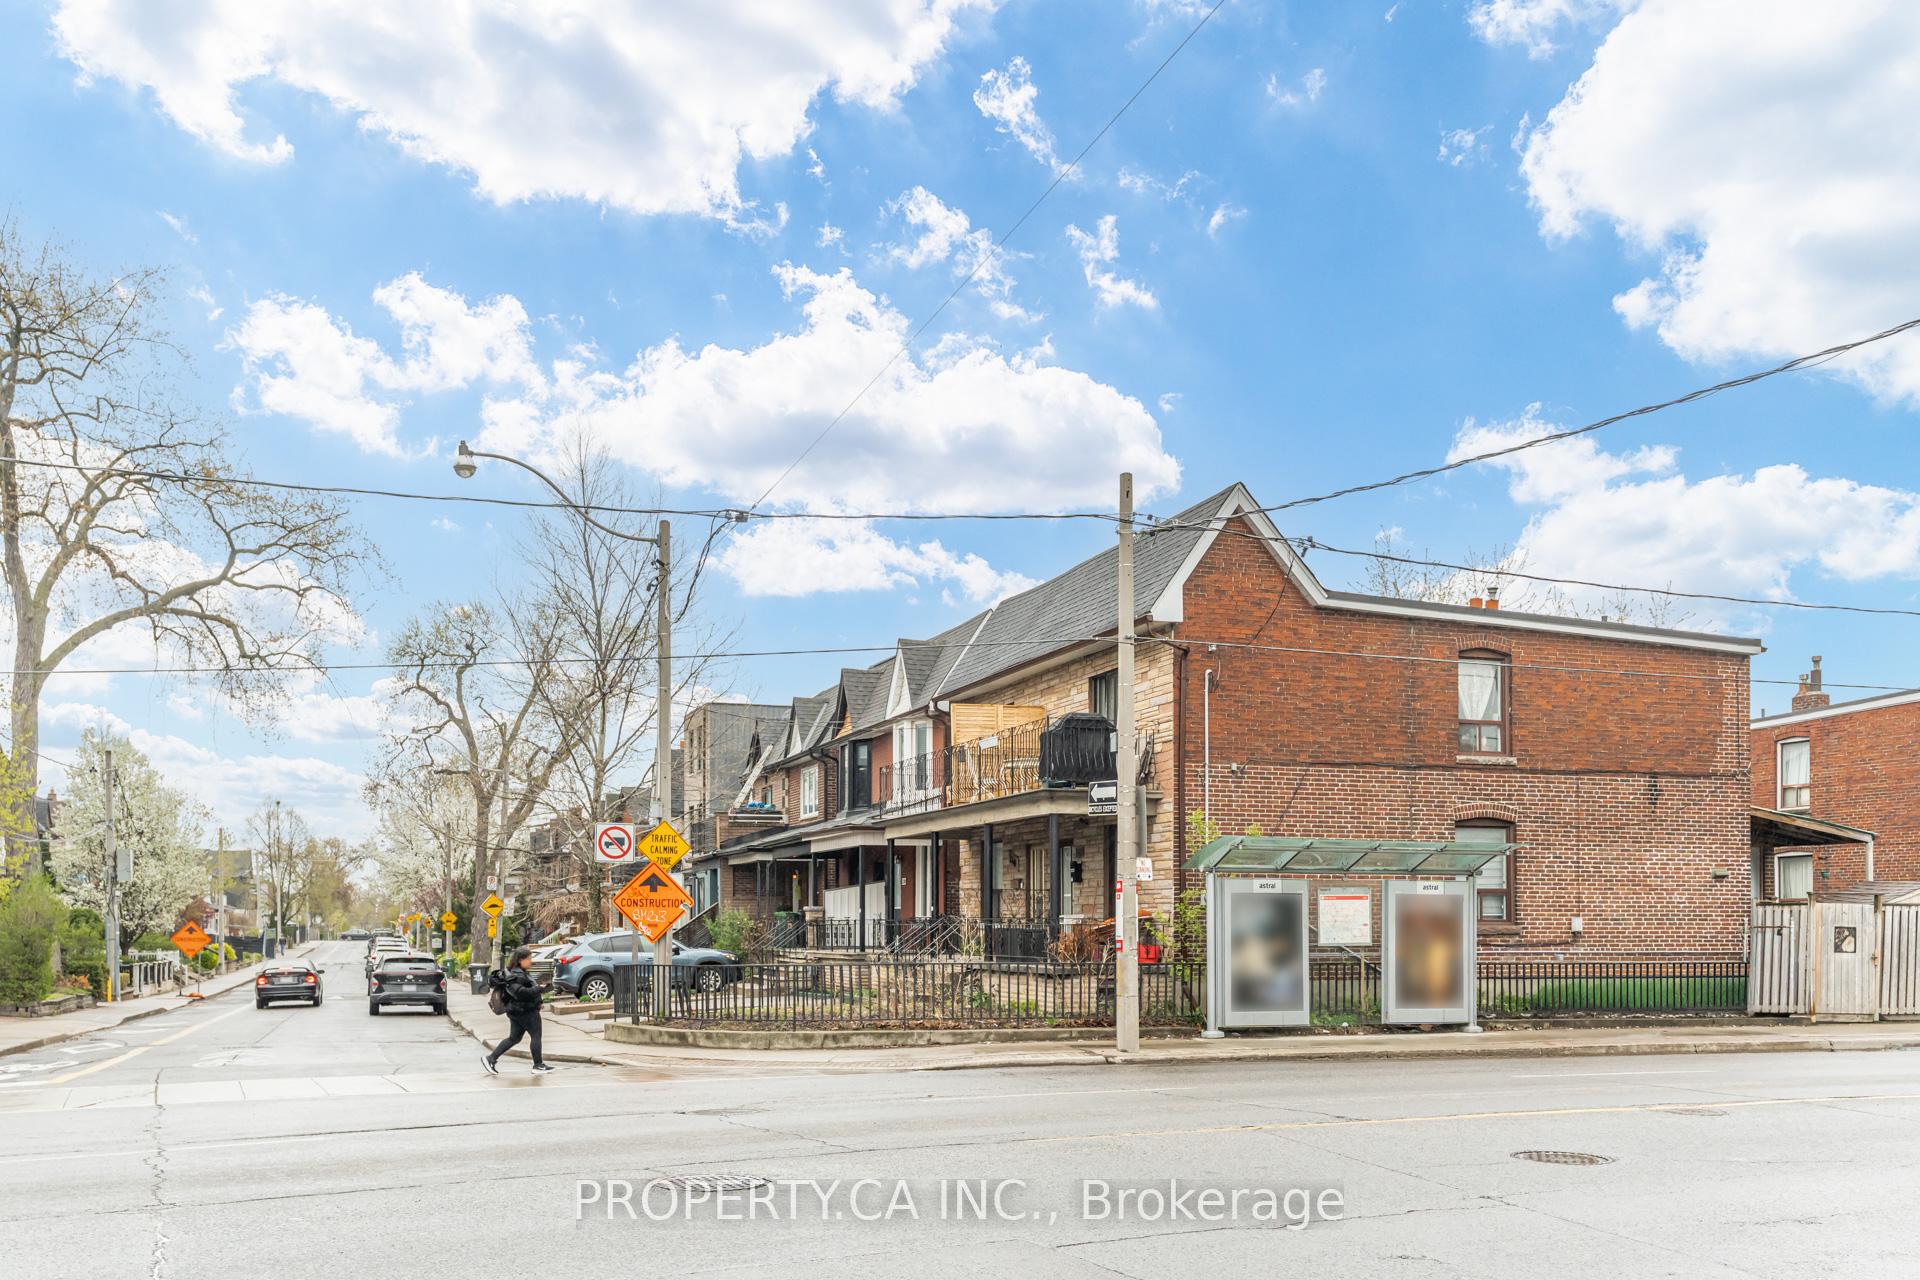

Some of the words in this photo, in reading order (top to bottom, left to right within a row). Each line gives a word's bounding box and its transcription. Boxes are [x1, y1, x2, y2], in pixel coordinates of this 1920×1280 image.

[651, 834, 677, 843] TRAFFIC
[650, 846, 678, 854] CALMING
[656, 857, 671, 865] ZONE
